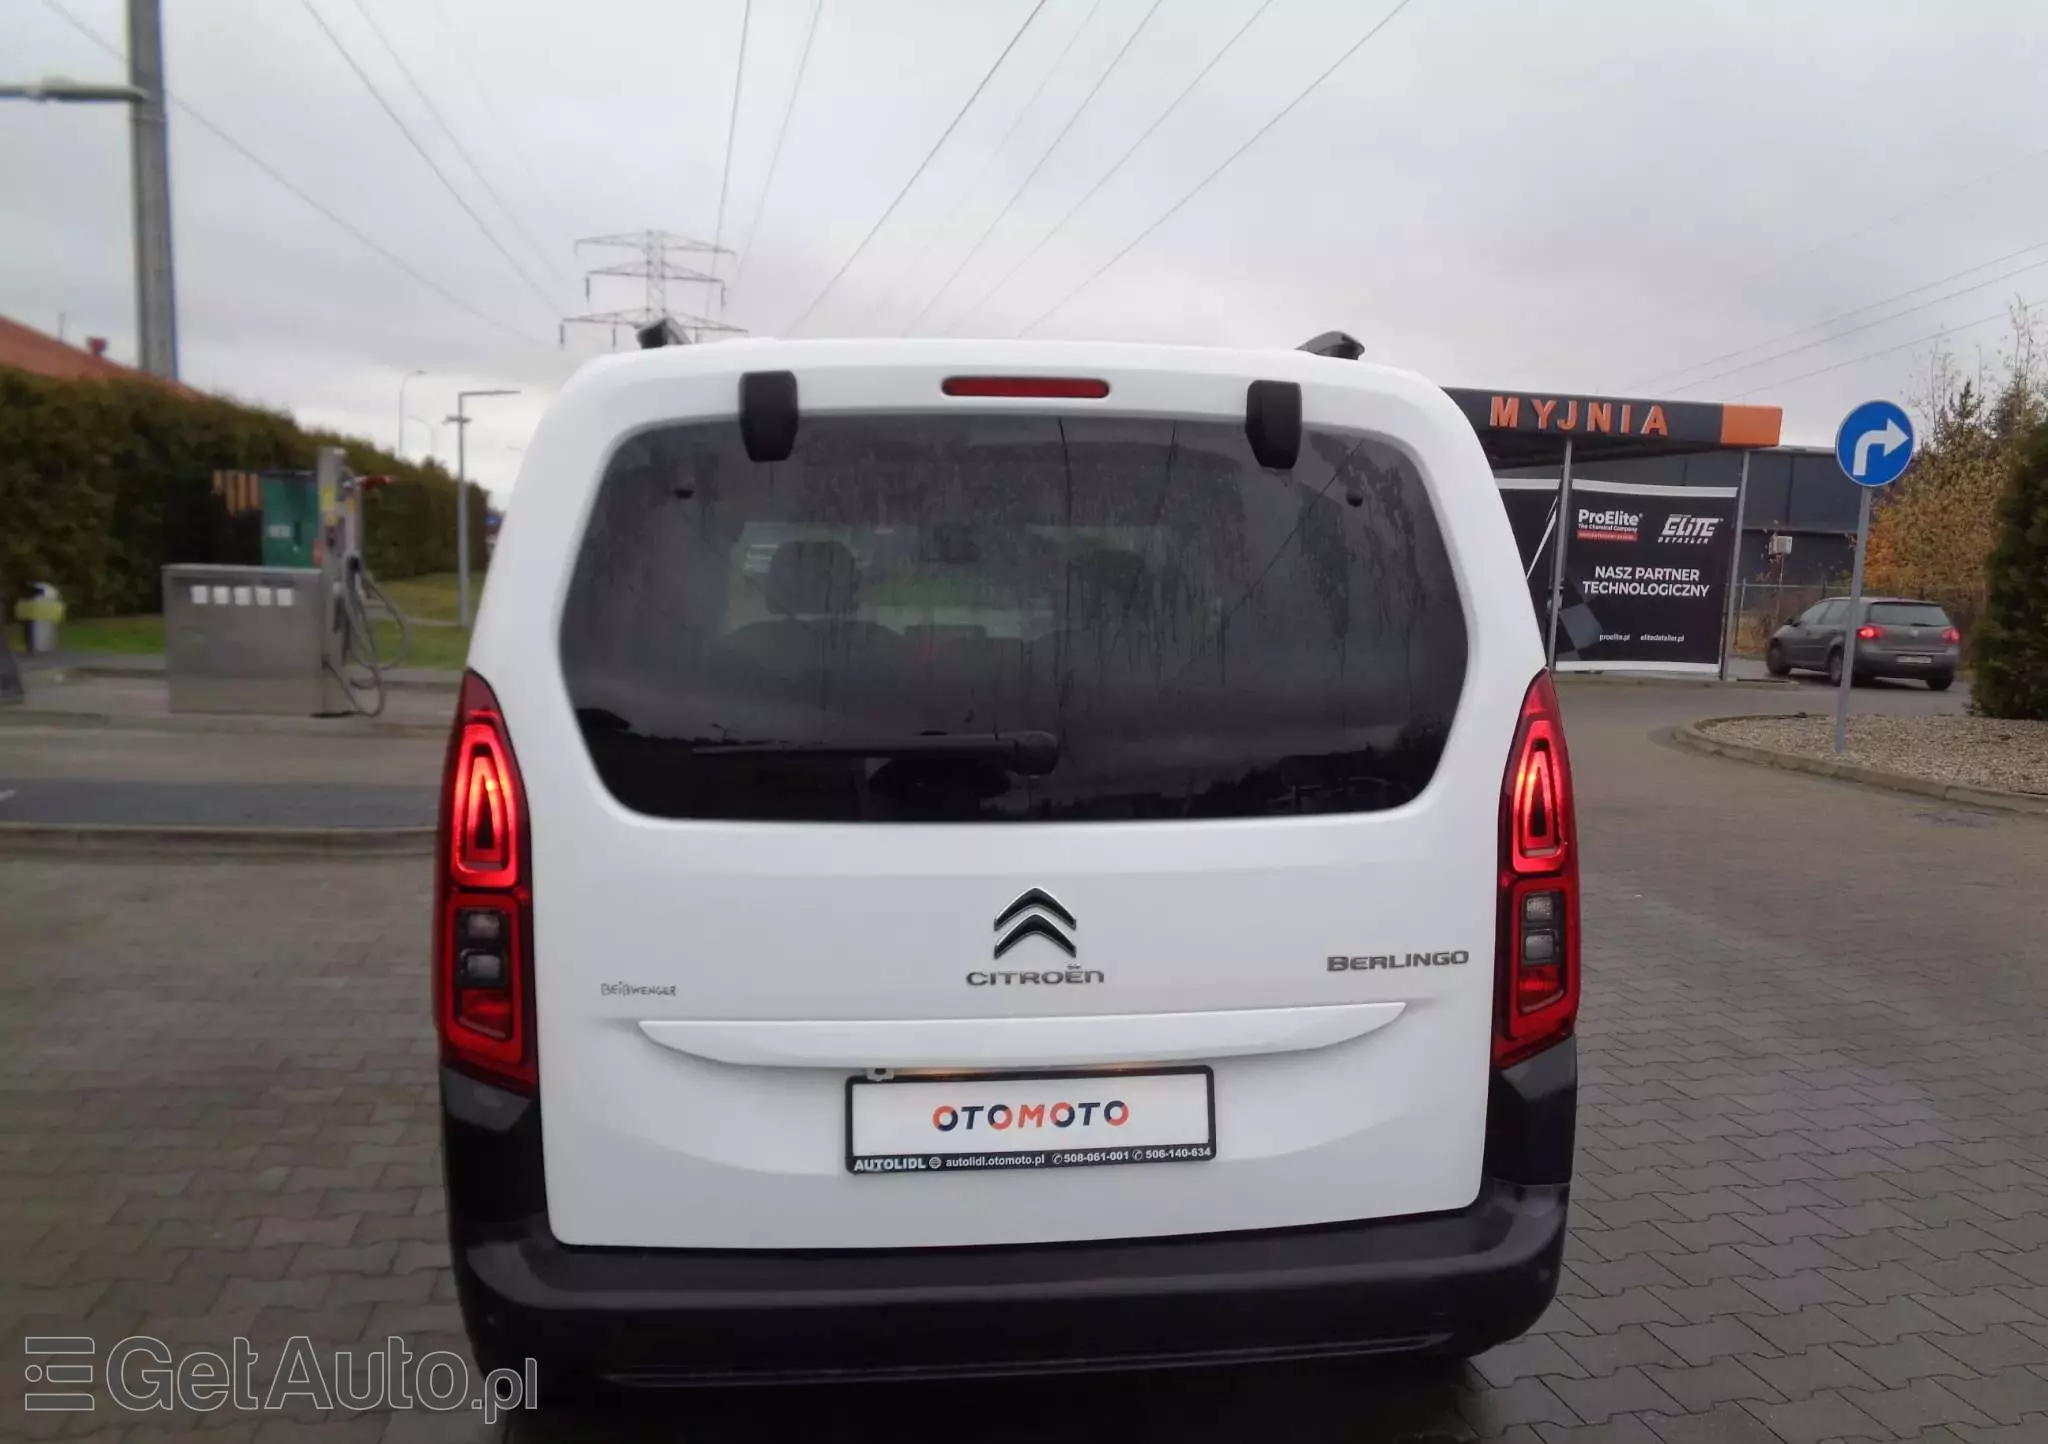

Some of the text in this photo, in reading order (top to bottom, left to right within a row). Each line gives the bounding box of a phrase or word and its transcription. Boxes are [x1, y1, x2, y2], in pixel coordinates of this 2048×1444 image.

[1489, 396, 1668, 436] MYJNIA
[1578, 509, 1639, 526] ProElite
[1595, 565, 1700, 582] NASZ PARTNER
[1582, 580, 1710, 597] TECHNOLOGICZNY
[1327, 950, 1469, 972] BERLINGO
[932, 1099, 1130, 1132] OTOMOTO
[854, 1147, 1211, 1171] AUTOLIDL autolidl.otomoto.pl 508-061-001 506-140-634
